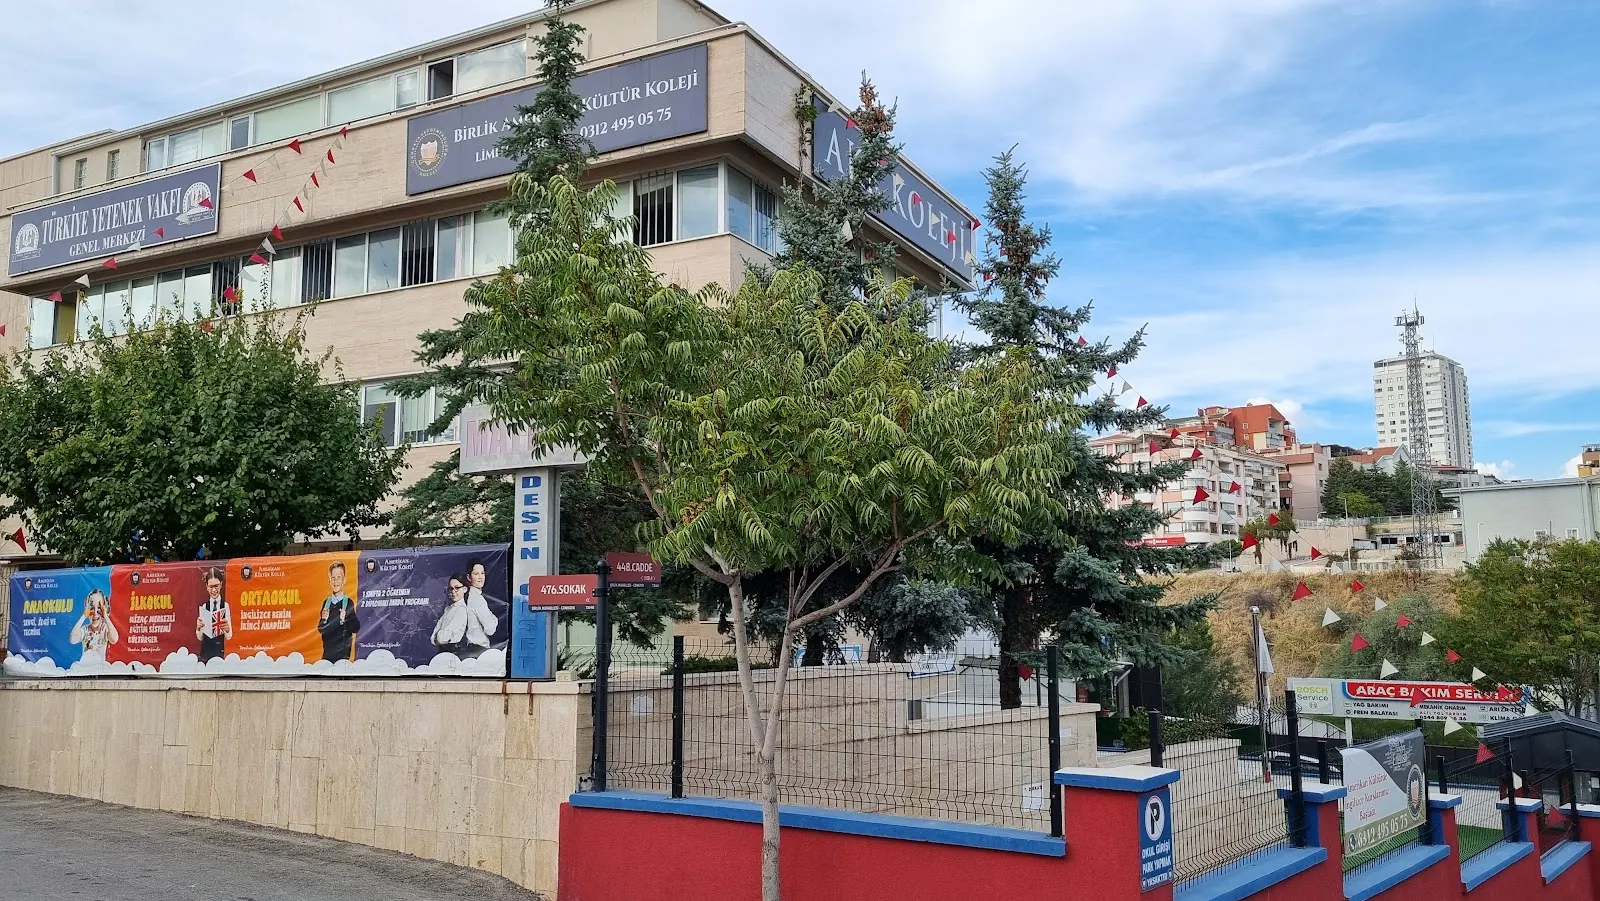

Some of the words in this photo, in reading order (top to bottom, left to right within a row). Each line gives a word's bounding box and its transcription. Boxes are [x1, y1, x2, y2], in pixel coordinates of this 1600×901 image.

[454, 120, 498, 142] BİRLİK
[582, 86, 641, 112] KÜLTÜR
[645, 69, 698, 97] KOLEJİ
[580, 121, 608, 138] 0312
[611, 115, 634, 132] 495
[638, 110, 654, 126] 05
[656, 106, 672, 122] 75
[42, 206, 88, 245] TÜRKİYE
[92, 196, 144, 234] YETENEK
[146, 187, 182, 221] VAKFI
[891, 173, 966, 263] KOLEJİ
[70, 240, 100, 257] GENEL
[102, 225, 146, 250] MERKEZİ
[520, 476, 542, 560] DESEN
[616, 562, 653, 573] 448.CADDE
[240, 588, 301, 606] ORTAOKUL
[540, 584, 586, 595] 476.SOKAK
[23, 598, 74, 614] ANAOKULU
[130, 590, 173, 610] İLKOKUL
[240, 609, 271, 620] İNGİLİZCE
[1356, 685, 1395, 698] ARAÇ
[1358, 827, 1375, 847] 0312
[1377, 821, 1389, 840] 495
[1390, 816, 1399, 834] 05
[1399, 813, 1408, 830] 75
[1142, 848, 1155, 859] OKUL
[1156, 839, 1170, 854] GİRİŞİ
[1142, 862, 1154, 875] PARK
[1154, 855, 1171, 870] YAPMAK
[1146, 872, 1168, 886] YASAKTIR
